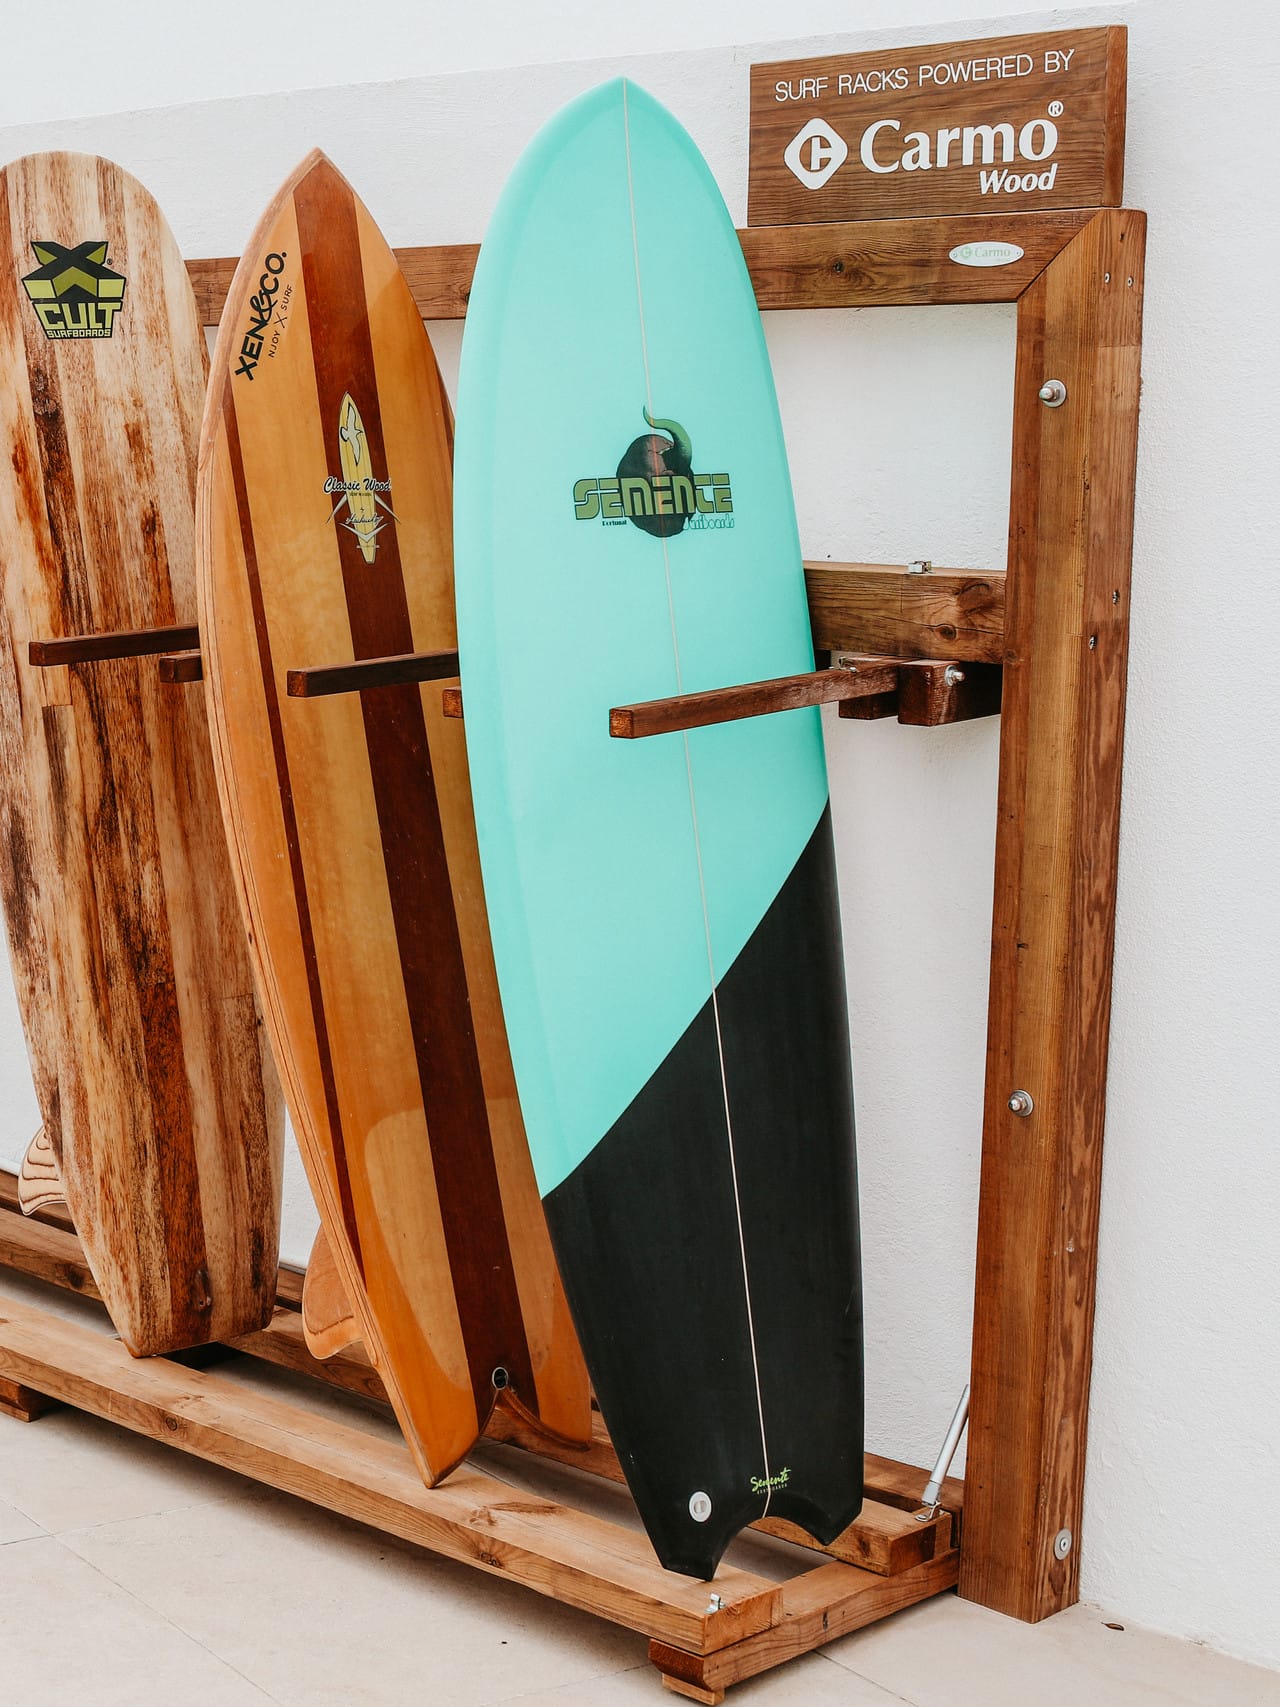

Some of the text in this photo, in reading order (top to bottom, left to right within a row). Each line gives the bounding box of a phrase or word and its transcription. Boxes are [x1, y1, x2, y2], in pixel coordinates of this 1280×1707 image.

[775, 48, 1075, 102] SURF RACKS POWERED BY
[860, 118, 1058, 174] Carmo
[979, 163, 1058, 195] Wood
[974, 246, 1011, 257] Carmo
[33, 302, 122, 330] CULT
[268, 331, 281, 358] NJOY
[280, 284, 294, 311] SURF
[47, 329, 111, 338] SURFBOARDS
[323, 476, 392, 494] Classic Wood
